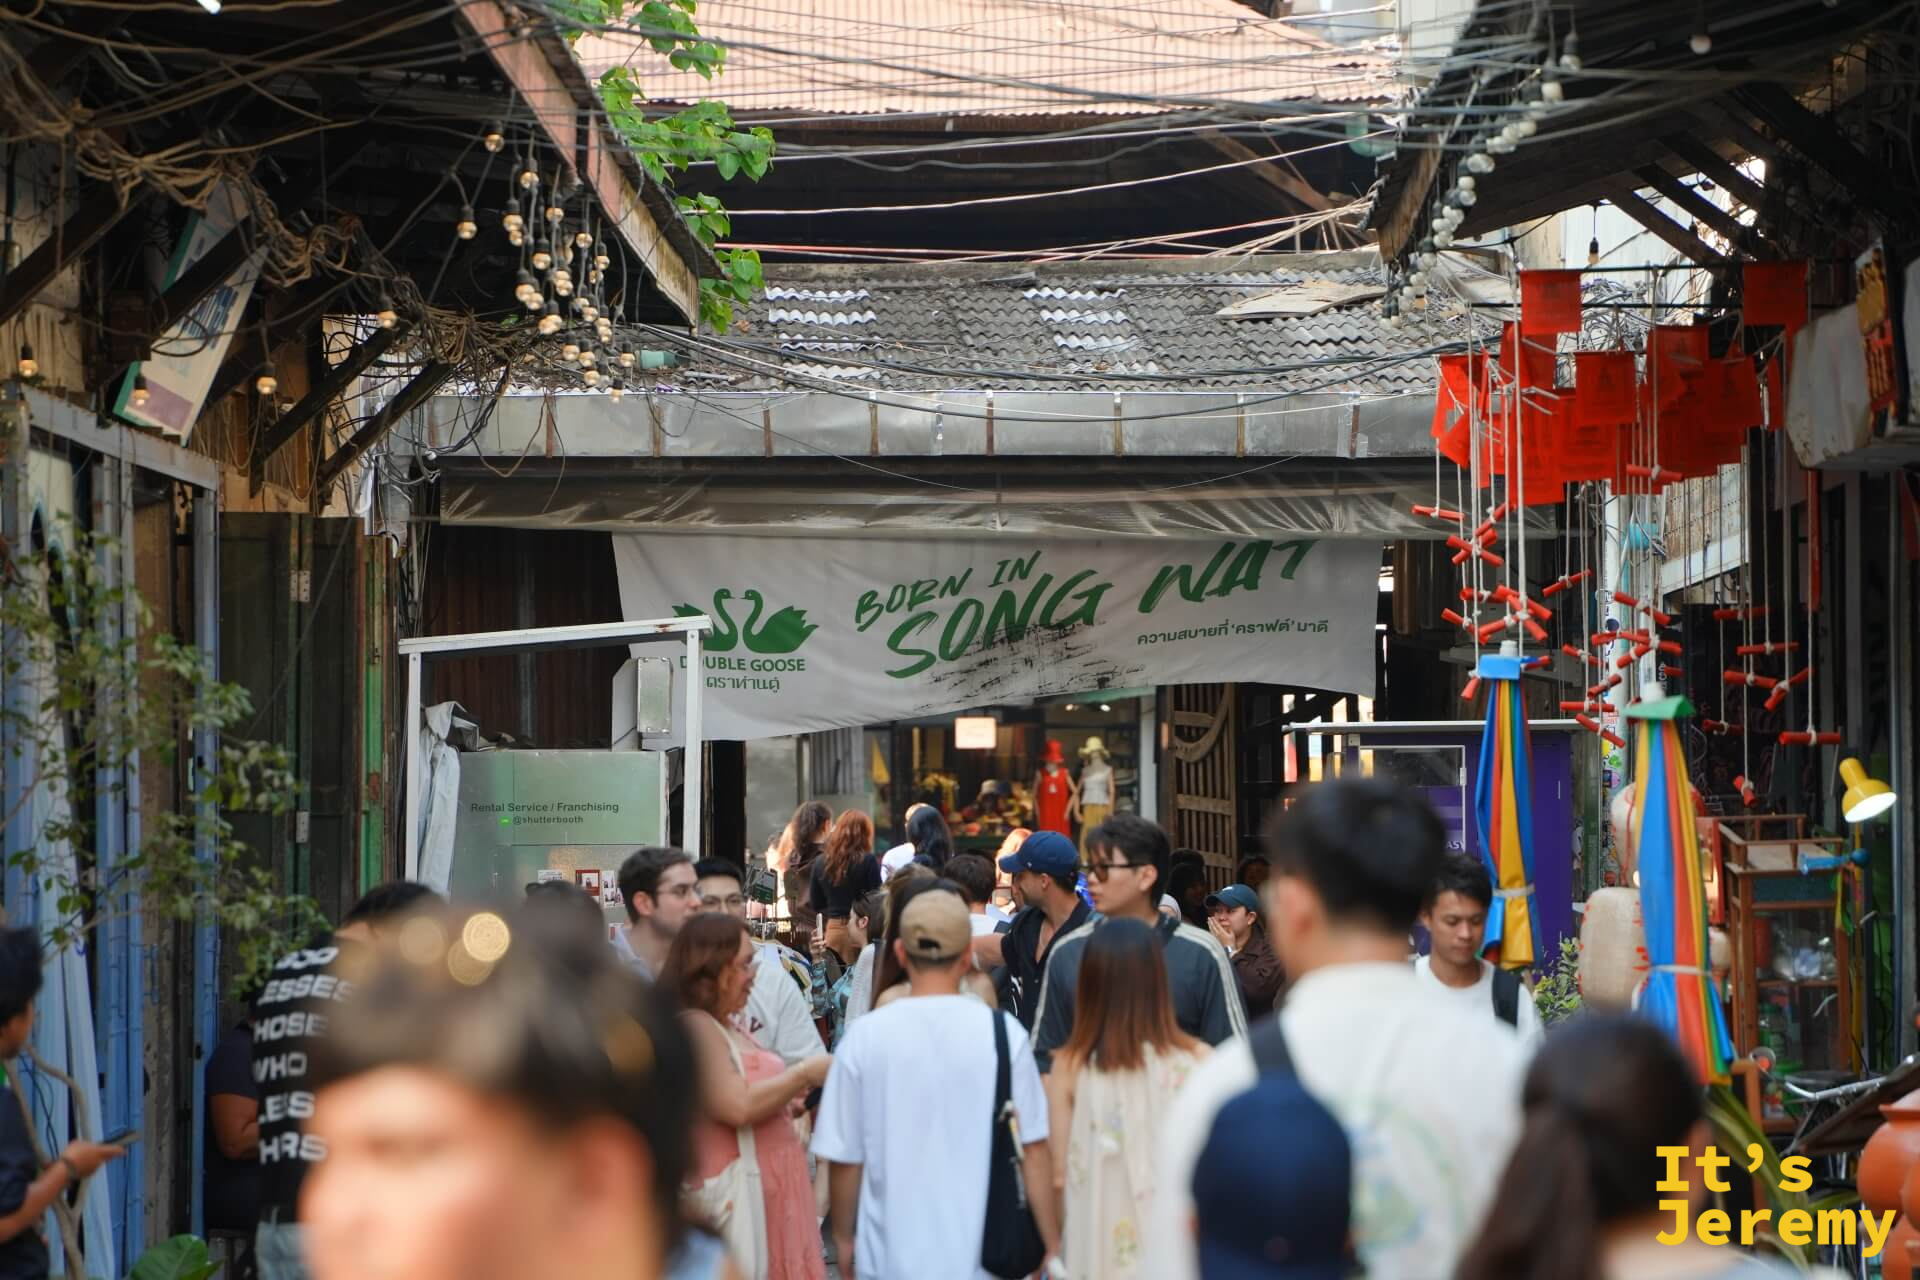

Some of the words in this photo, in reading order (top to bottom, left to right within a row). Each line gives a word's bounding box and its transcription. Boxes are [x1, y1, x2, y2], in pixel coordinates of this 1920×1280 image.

[855, 567, 974, 632] BORN
[988, 550, 1042, 588] IN
[885, 569, 1114, 680] SONG
[1137, 539, 1321, 614] WAT
[680, 655, 747, 671] DUBLE
[750, 658, 806, 672] GOOSE
[471, 802, 505, 813] Rental
[507, 802, 549, 813] Service
[557, 802, 620, 814] Franchising
[512, 815, 584, 825] @shutterbooth
